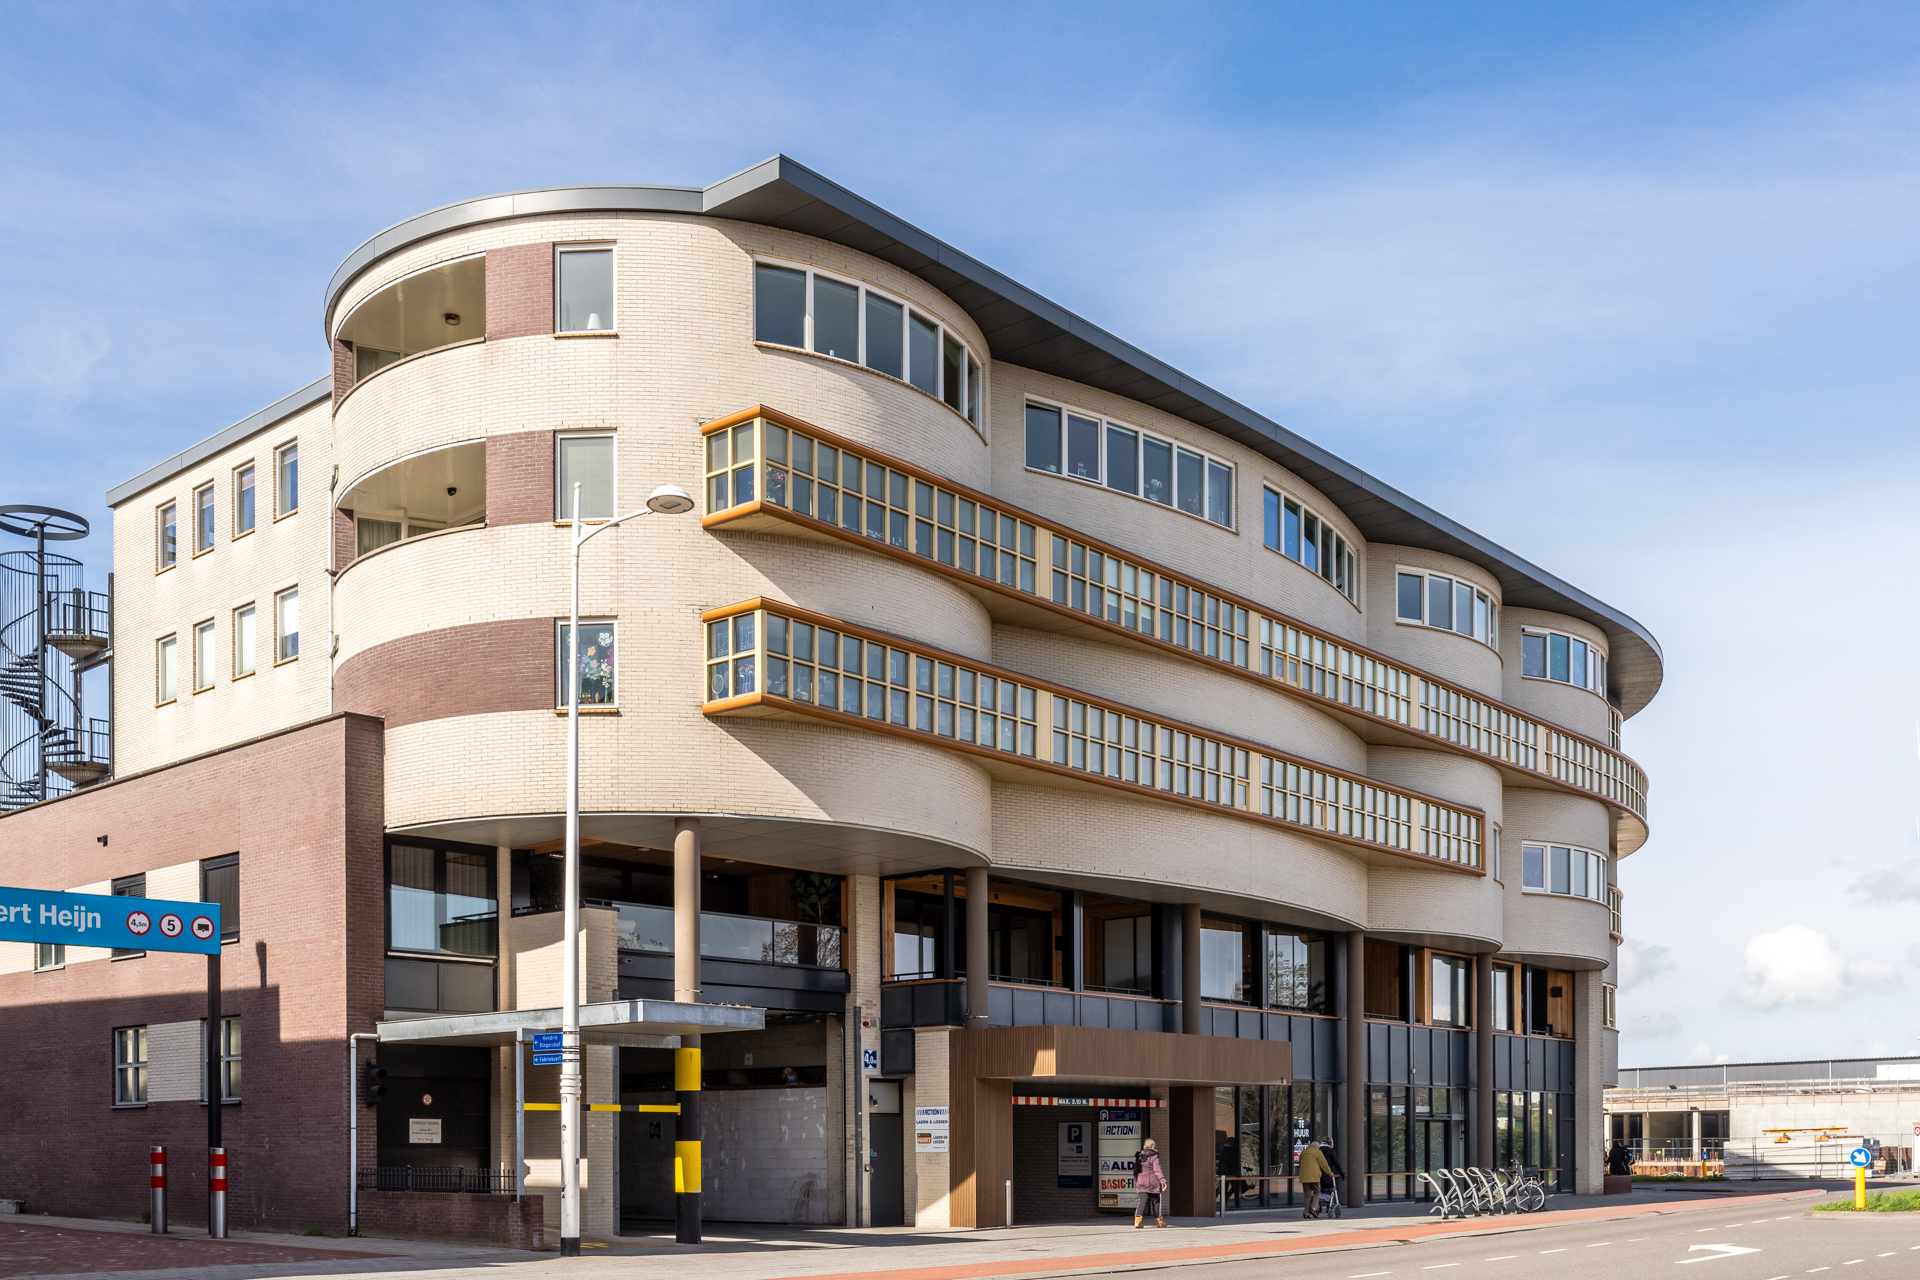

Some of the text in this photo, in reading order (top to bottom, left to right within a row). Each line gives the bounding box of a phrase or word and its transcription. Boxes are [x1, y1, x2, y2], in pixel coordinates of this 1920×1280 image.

[39, 904, 102, 933] Heijn
[130, 918, 148, 929] 4,5m
[167, 919, 176, 932] 5
[1298, 1120, 1304, 1128] TE
[1071, 1128, 1080, 1140] P
[1106, 1126, 1134, 1136] ACTION
[1294, 1129, 1309, 1137] HUUR
[1111, 1161, 1135, 1171] ALD
[1101, 1178, 1136, 1190] BASIC-FI
